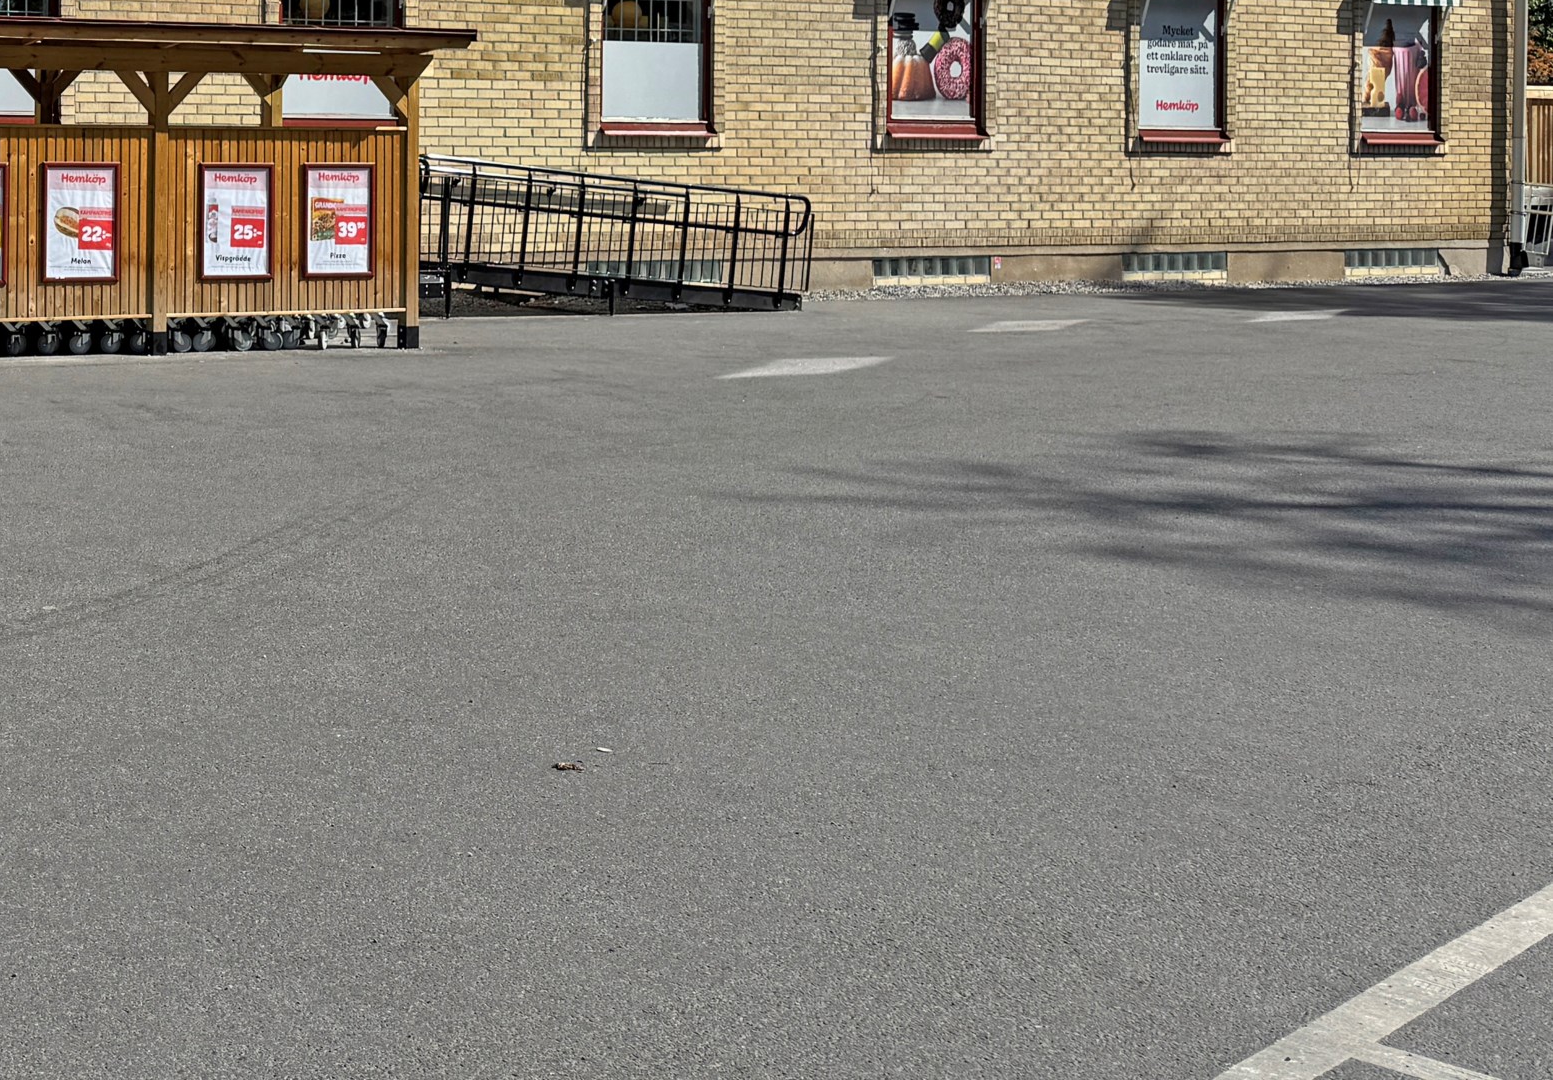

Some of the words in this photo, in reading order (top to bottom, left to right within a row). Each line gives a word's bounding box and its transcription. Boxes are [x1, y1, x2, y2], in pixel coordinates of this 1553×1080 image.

[1162, 25, 1194, 37] Mycket
[1147, 38, 1177, 50] godare
[1146, 51, 1158, 61] ett
[1160, 51, 1193, 61] enklare
[1194, 52, 1209, 62] och
[1147, 64, 1189, 76] trevligare
[1156, 99, 1199, 113] Hemköp
[61, 173, 107, 185] Hemköp
[214, 172, 258, 185] Hemköp
[318, 171, 360, 183] Hemköp
[82, 226, 112, 242] 22:-
[234, 224, 263, 240] 25:-
